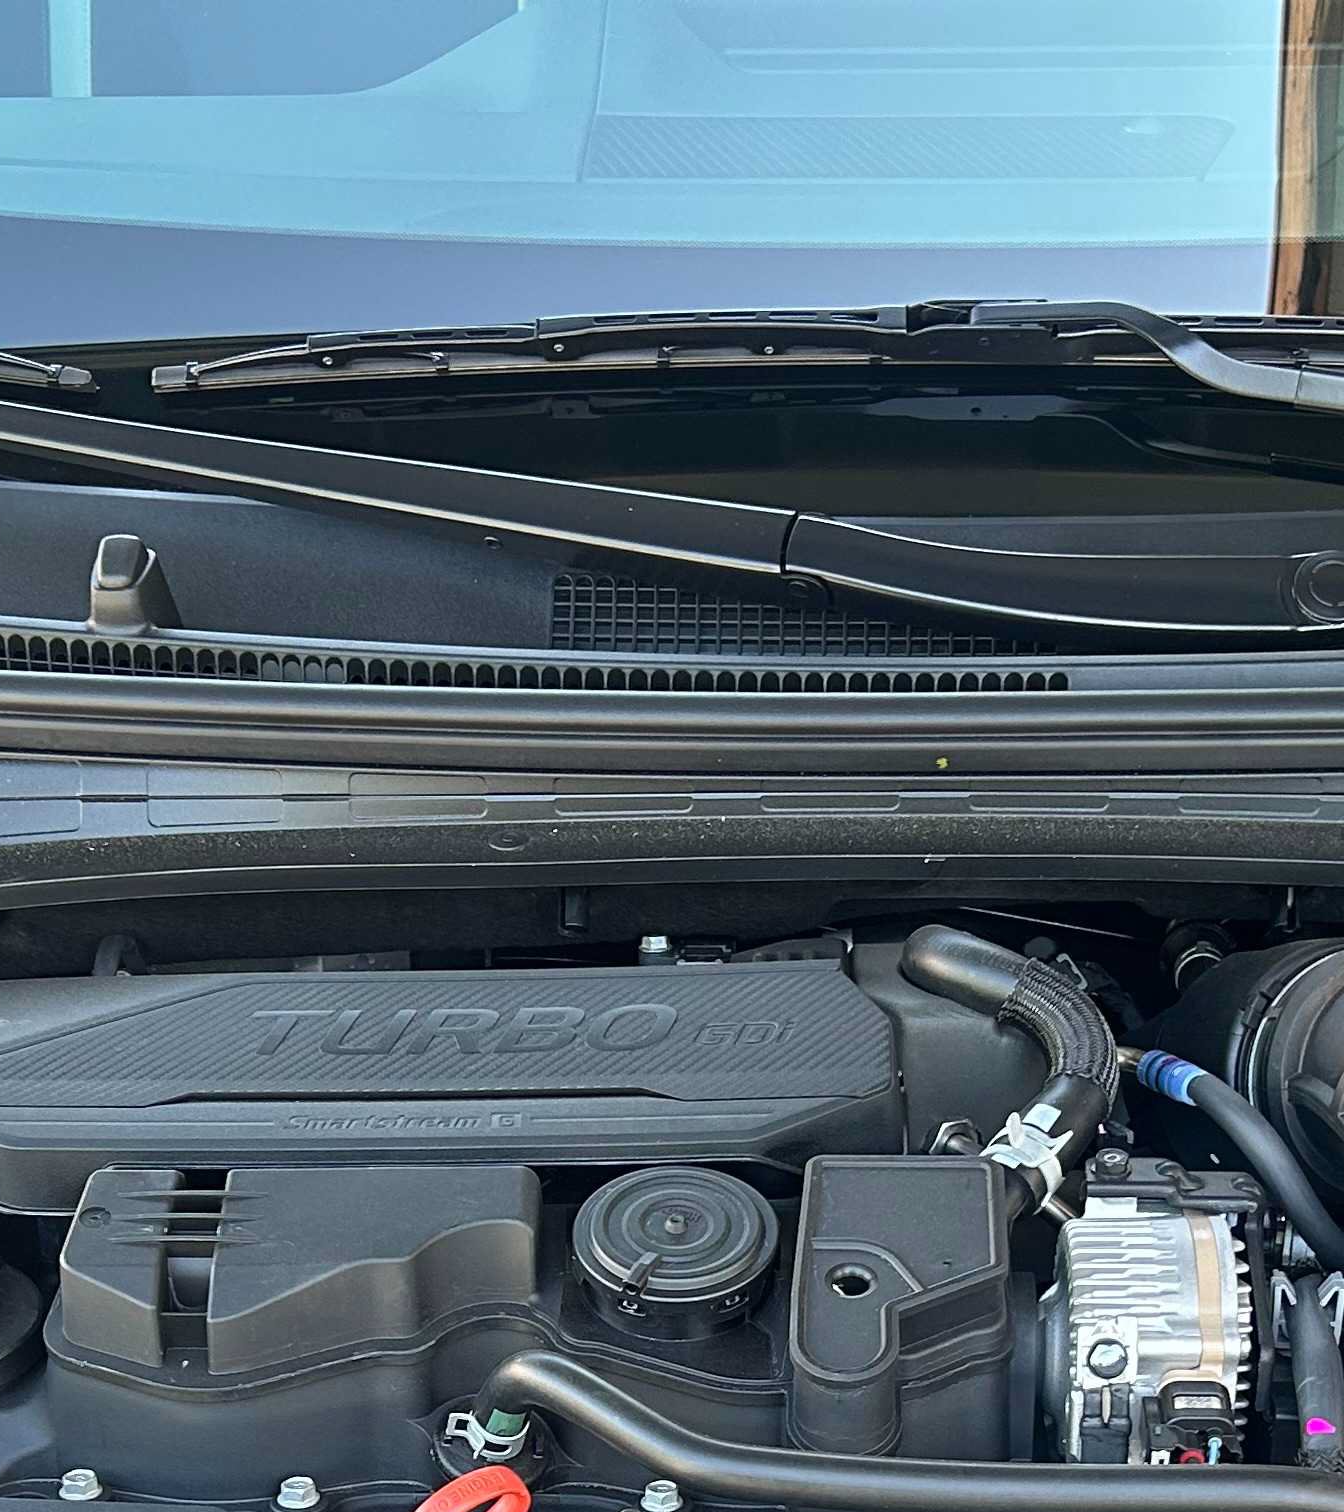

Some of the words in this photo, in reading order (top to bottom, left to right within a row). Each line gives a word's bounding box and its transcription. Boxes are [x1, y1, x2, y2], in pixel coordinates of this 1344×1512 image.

[253, 1004, 678, 1056] TURBO
[692, 1020, 794, 1046] GDi
[281, 1113, 480, 1131] Smartstream
